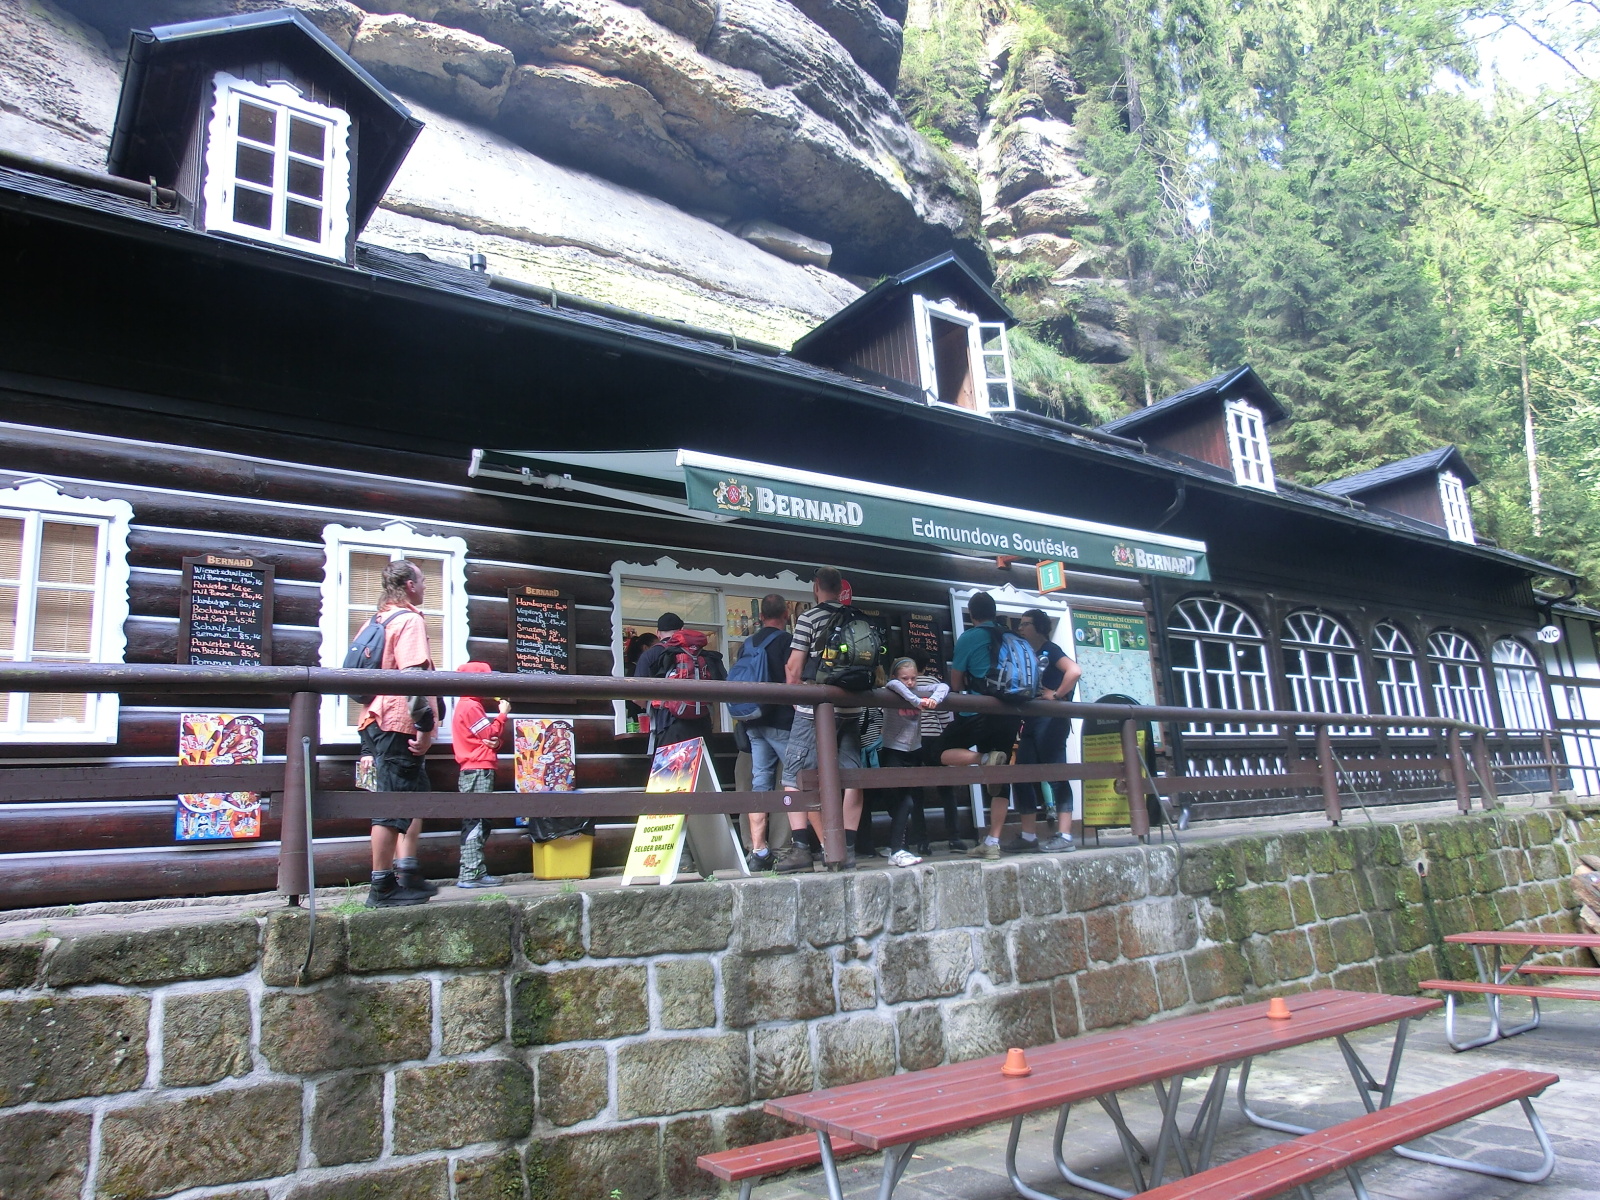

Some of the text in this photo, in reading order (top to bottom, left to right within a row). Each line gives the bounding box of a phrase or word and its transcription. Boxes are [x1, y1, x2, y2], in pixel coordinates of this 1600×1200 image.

[755, 486, 863, 527] BERNARD
[911, 517, 1079, 559] Edmundova Soutěska
[207, 555, 254, 568] BERNARD
[1134, 548, 1195, 576] BERNARD
[525, 586, 560, 597] BERNARD
[1541, 629, 1559, 639] WC
[650, 835, 663, 843] ZUM
